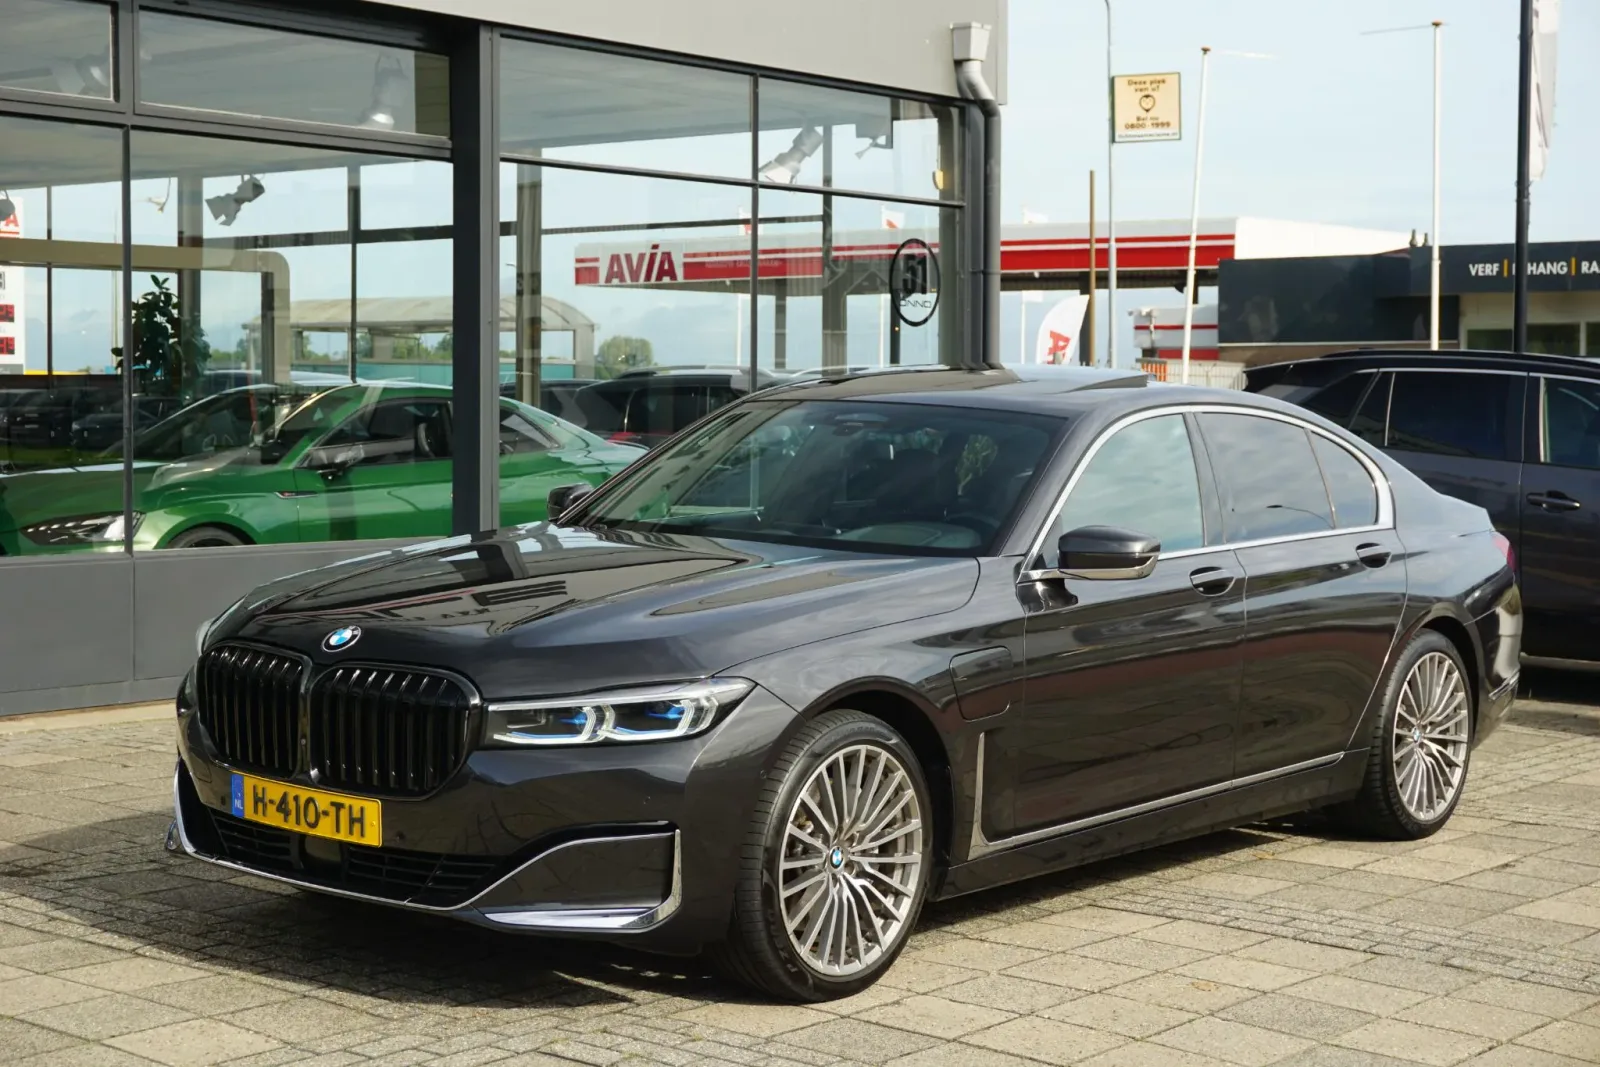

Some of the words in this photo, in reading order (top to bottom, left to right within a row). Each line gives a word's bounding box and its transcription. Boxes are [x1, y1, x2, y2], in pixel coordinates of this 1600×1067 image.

[1124, 122, 1147, 130] 0800
[604, 244, 678, 284] AVIA
[902, 253, 927, 295] 51
[1469, 263, 1500, 276] VERF
[1512, 261, 1568, 275] HANG
[1581, 260, 1600, 274] RA
[234, 798, 244, 810] NL
[252, 784, 366, 838] H-410-TH
